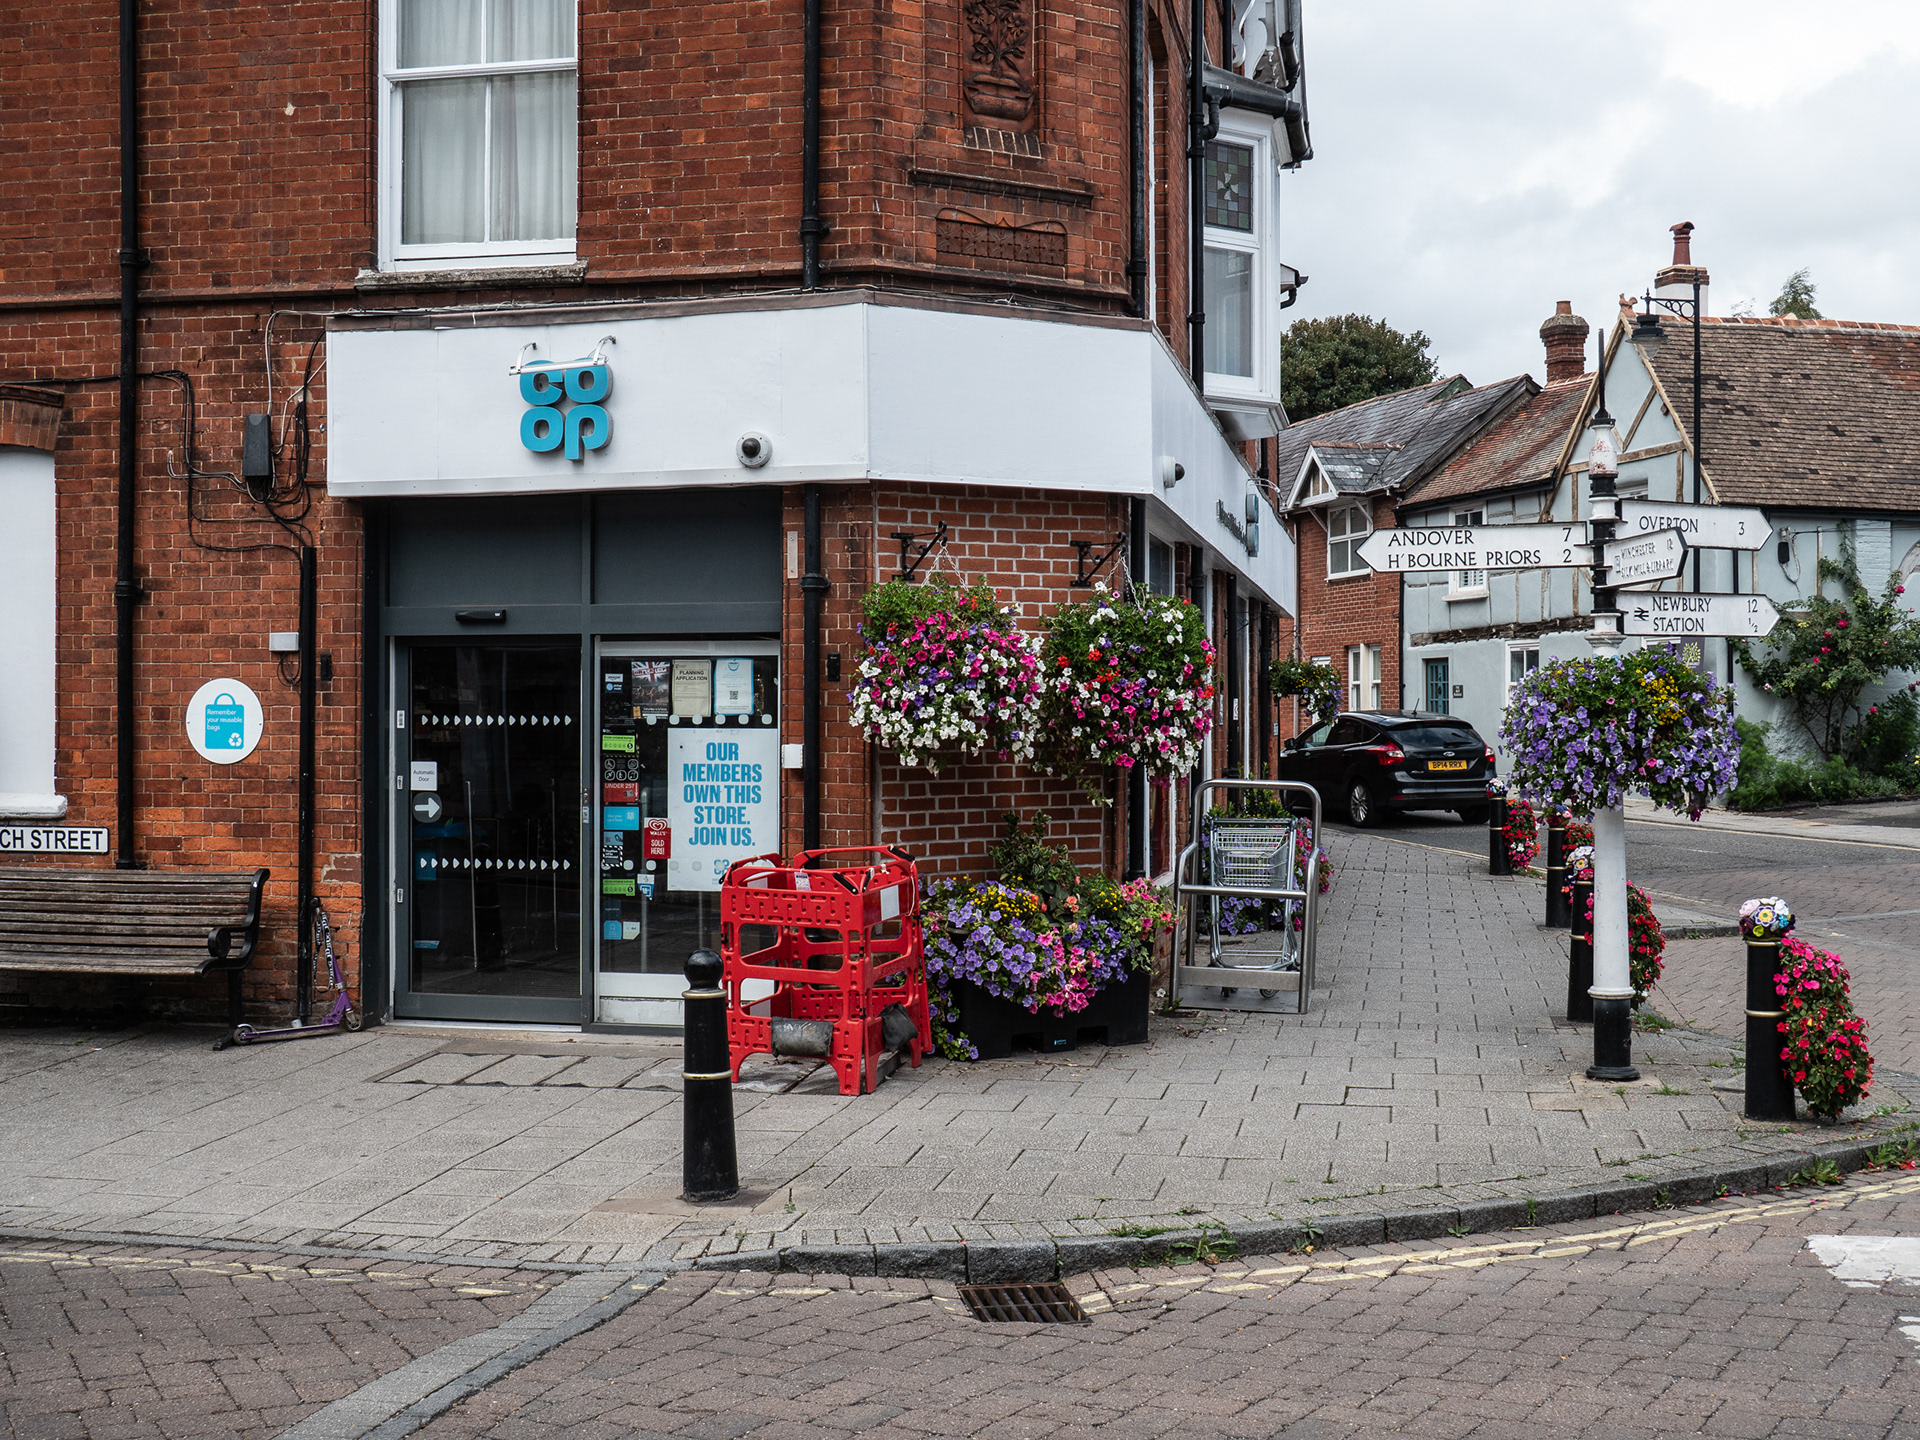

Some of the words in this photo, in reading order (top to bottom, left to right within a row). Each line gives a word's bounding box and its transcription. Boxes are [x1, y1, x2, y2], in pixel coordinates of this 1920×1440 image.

[1639, 516, 1699, 533] OVERTON
[1738, 522, 1745, 535] 3
[1388, 530, 1474, 547] ANDOVER
[1562, 528, 1572, 542] 7
[1486, 549, 1541, 566] PRIORS
[1563, 548, 1572, 563] 2
[1621, 542, 1656, 559] WINCHESTER
[1667, 538, 1674, 551] 12
[1634, 563, 1646, 577] MILL
[1651, 558, 1674, 574] LIBRARY
[1652, 597, 1711, 612] NEWBURY
[1747, 599, 1758, 613] 12
[1653, 617, 1705, 632] STATION
[207, 724, 220, 732] bags
[706, 742, 739, 761] OUR
[683, 763, 762, 782] MEMBERS
[1433, 761, 1448, 769] BP14
[683, 784, 721, 803] OWN
[724, 785, 762, 804] THIS
[694, 806, 751, 825] STORE.
[31, 829, 103, 850] STREET
[651, 839, 665, 847] SOLD
[688, 827, 727, 846] JOIN
[731, 828, 756, 846] US.
[651, 847, 665, 855] HERE!
